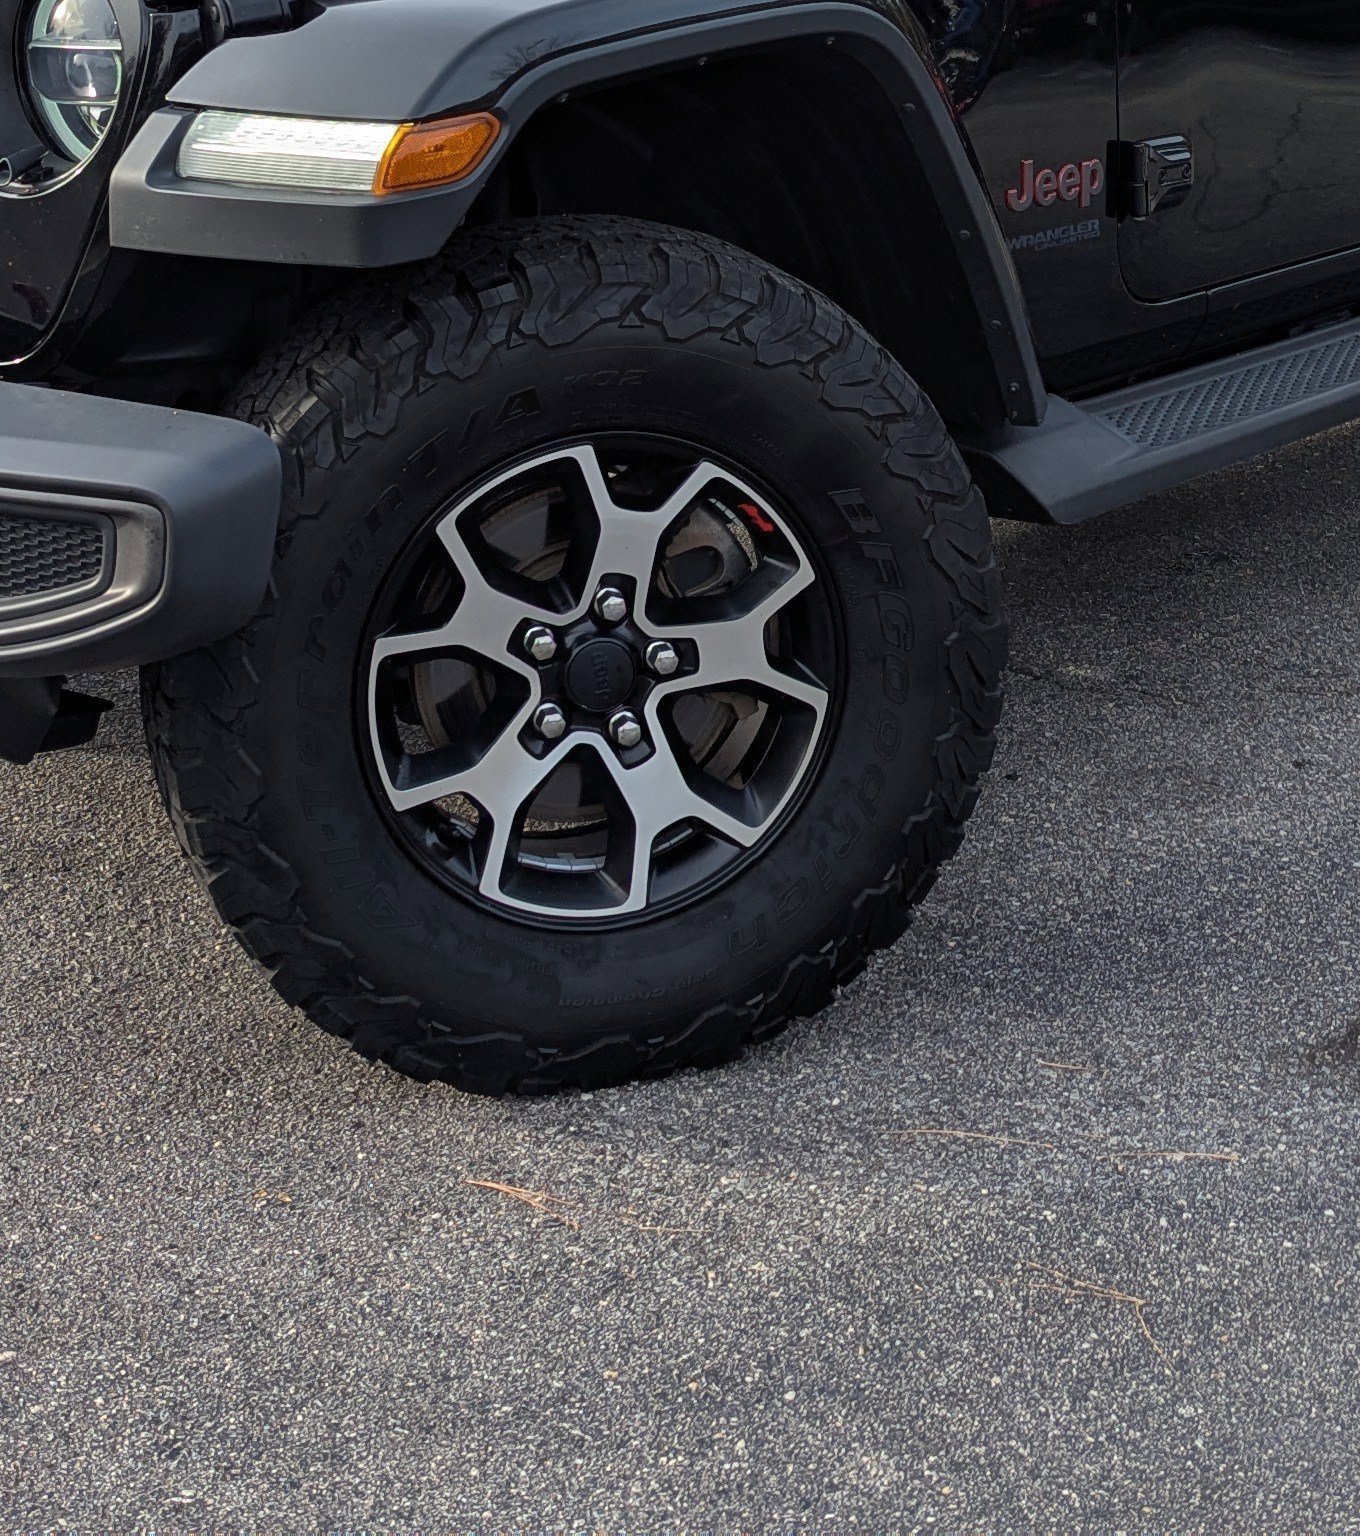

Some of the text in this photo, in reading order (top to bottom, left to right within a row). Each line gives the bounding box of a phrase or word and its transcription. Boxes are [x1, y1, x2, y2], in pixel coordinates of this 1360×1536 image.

[1004, 158, 1104, 212] Jeep
[1007, 219, 1101, 250] WRANGLER
[727, 488, 914, 958] BFGoodrich
